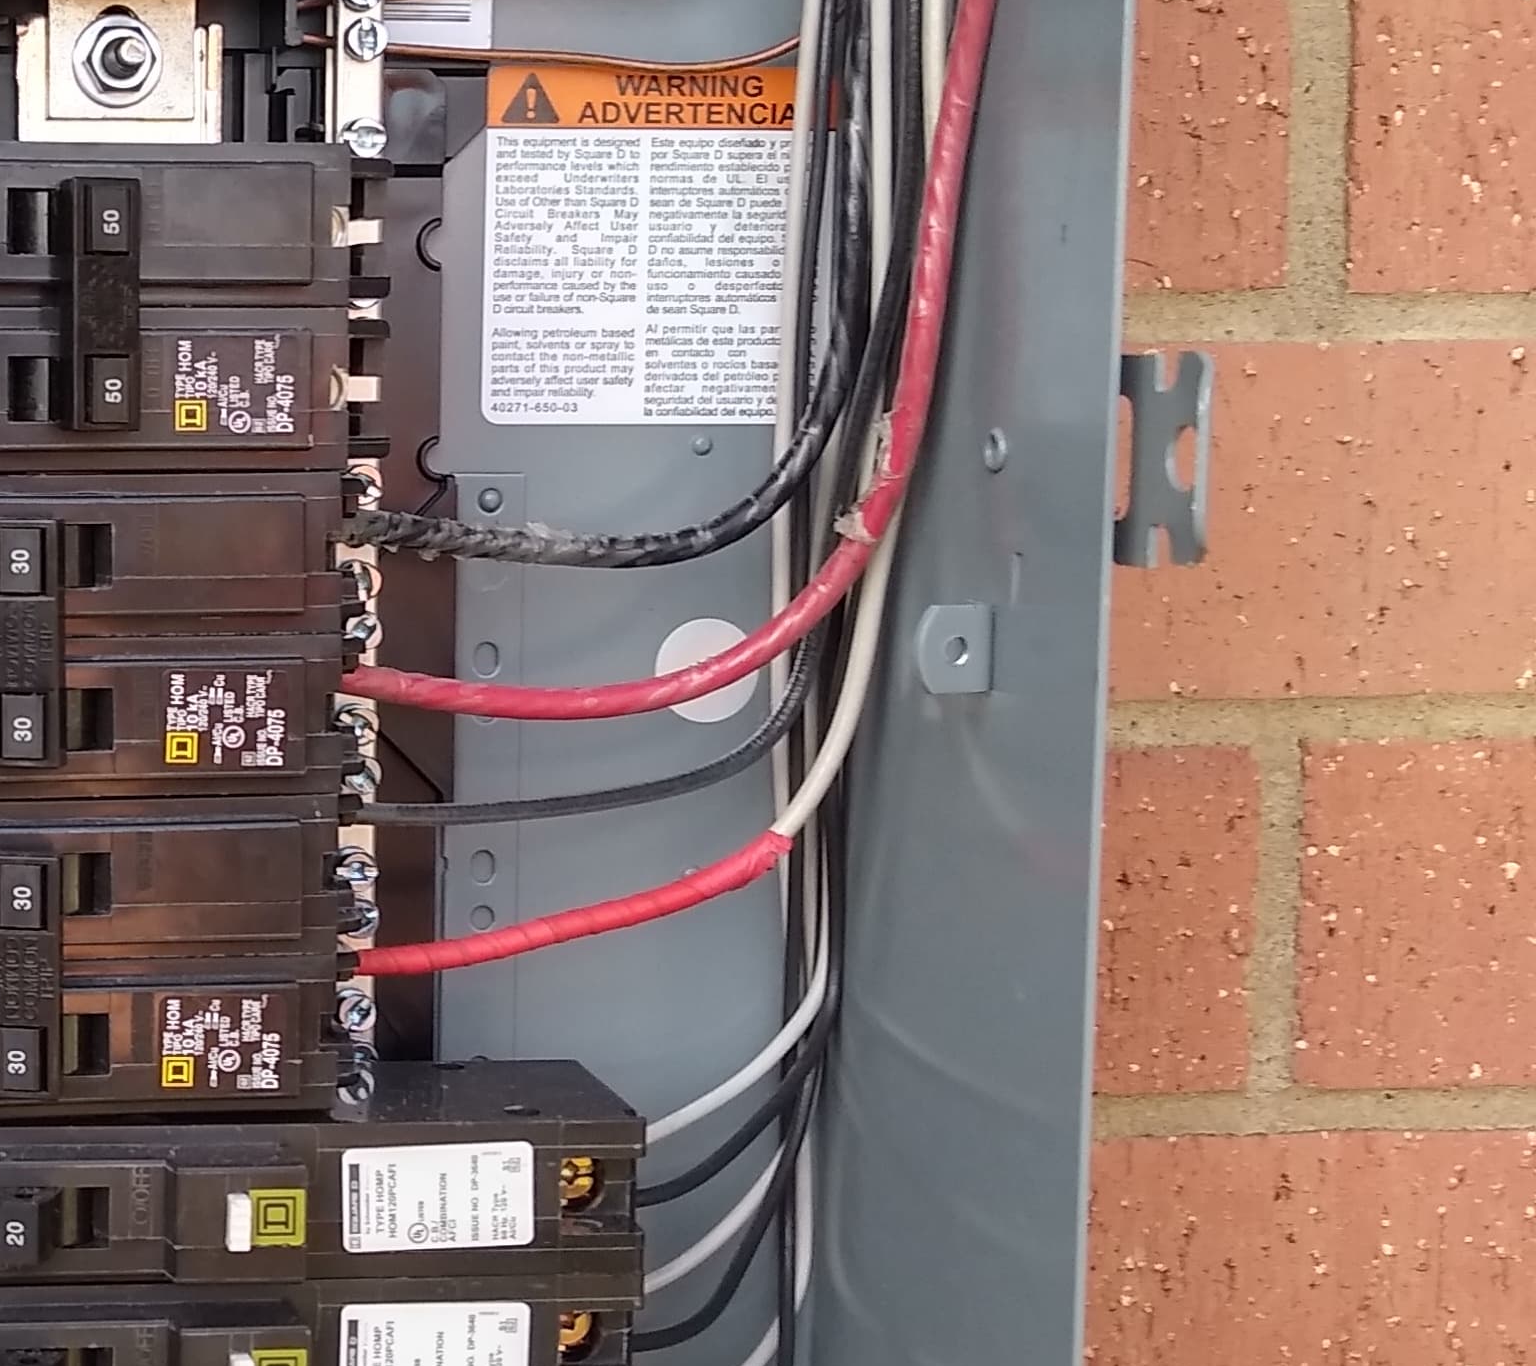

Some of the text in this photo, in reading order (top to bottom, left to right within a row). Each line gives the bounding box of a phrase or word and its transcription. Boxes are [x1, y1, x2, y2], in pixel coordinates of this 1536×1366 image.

[615, 74, 764, 98] WARNING
[577, 101, 795, 125] ADVERTENCIA
[496, 136, 640, 150] This equipment is designed
[495, 174, 639, 183] exceed Underwriters
[496, 161, 639, 173] performance levels which
[496, 185, 570, 195] Laboratories
[103, 209, 121, 235] 50
[494, 221, 639, 233] Adversely Affect User
[495, 209, 638, 221] Circuit Breakers May
[571, 244, 614, 256] Square
[629, 245, 638, 254] D
[646, 324, 755, 336] Al permitir que las
[491, 352, 635, 361] contact the non-metallic
[175, 340, 192, 398] TYPE HOM
[491, 364, 634, 375] parts of this product may
[105, 378, 123, 403] 50
[194, 381, 207, 398] 10
[276, 375, 294, 432] DP-4075
[490, 402, 578, 413] 40271-650-03
[11, 549, 30, 574] 30
[166, 674, 184, 731] TYPE HOM
[13, 717, 33, 742] 30
[187, 715, 199, 731] 10
[266, 709, 285, 766] DP-4075
[13, 886, 32, 911] 30
[162, 999, 181, 1055] TYPE HOM
[182, 1039, 194, 1055] 10
[7, 1050, 26, 1075] 30
[261, 1033, 280, 1089] DP-4075
[375, 1170, 385, 1233] TYPE HOMP
[439, 1173, 447, 1243] COMBINATION
[6, 1221, 25, 1247] 20
[372, 1326, 382, 1359] HOMP
